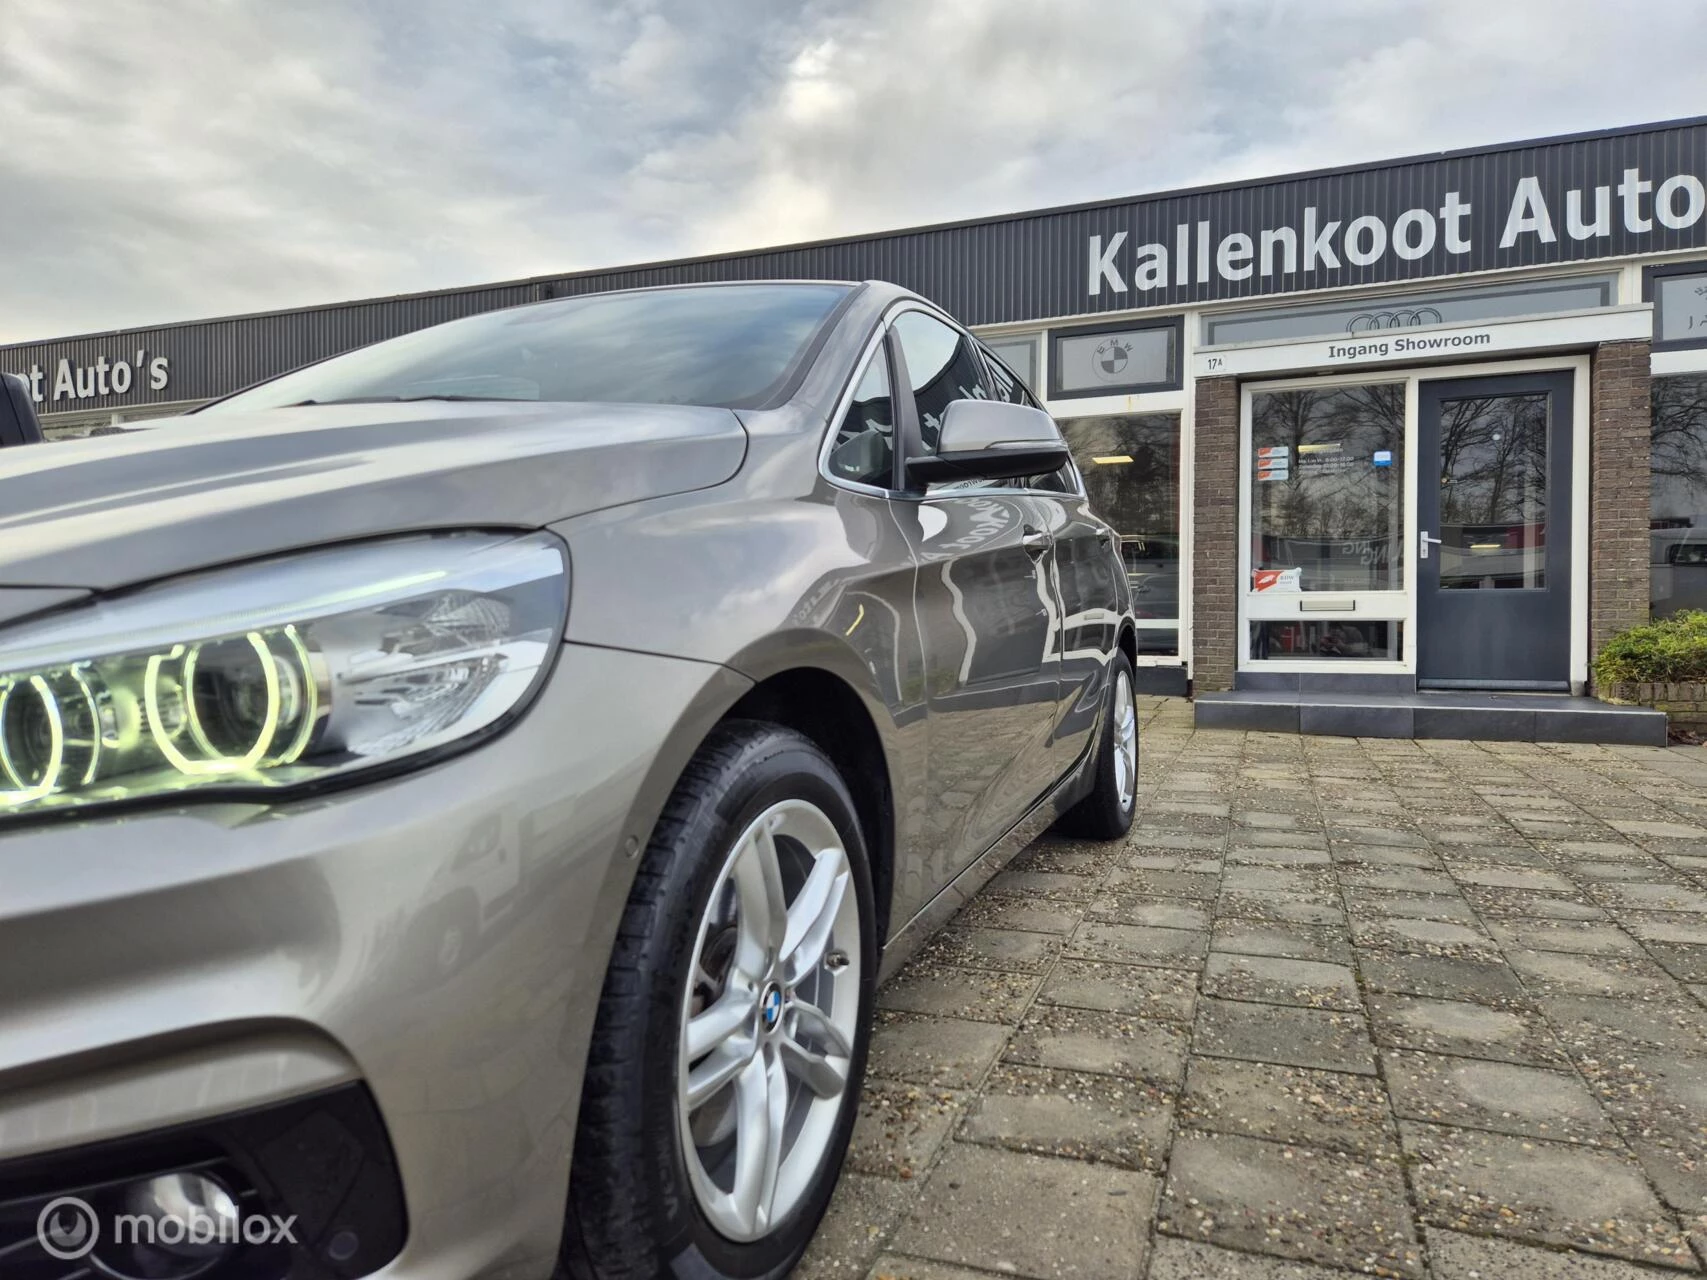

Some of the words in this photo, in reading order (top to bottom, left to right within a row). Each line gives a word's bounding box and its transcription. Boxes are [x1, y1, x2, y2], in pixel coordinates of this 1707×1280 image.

[1088, 191, 1472, 296] Kallenkoot
[1499, 168, 1706, 249] Auto
[1328, 342, 1389, 359] Ingang
[1394, 333, 1491, 352] Showroom
[53, 349, 169, 401] Auto's
